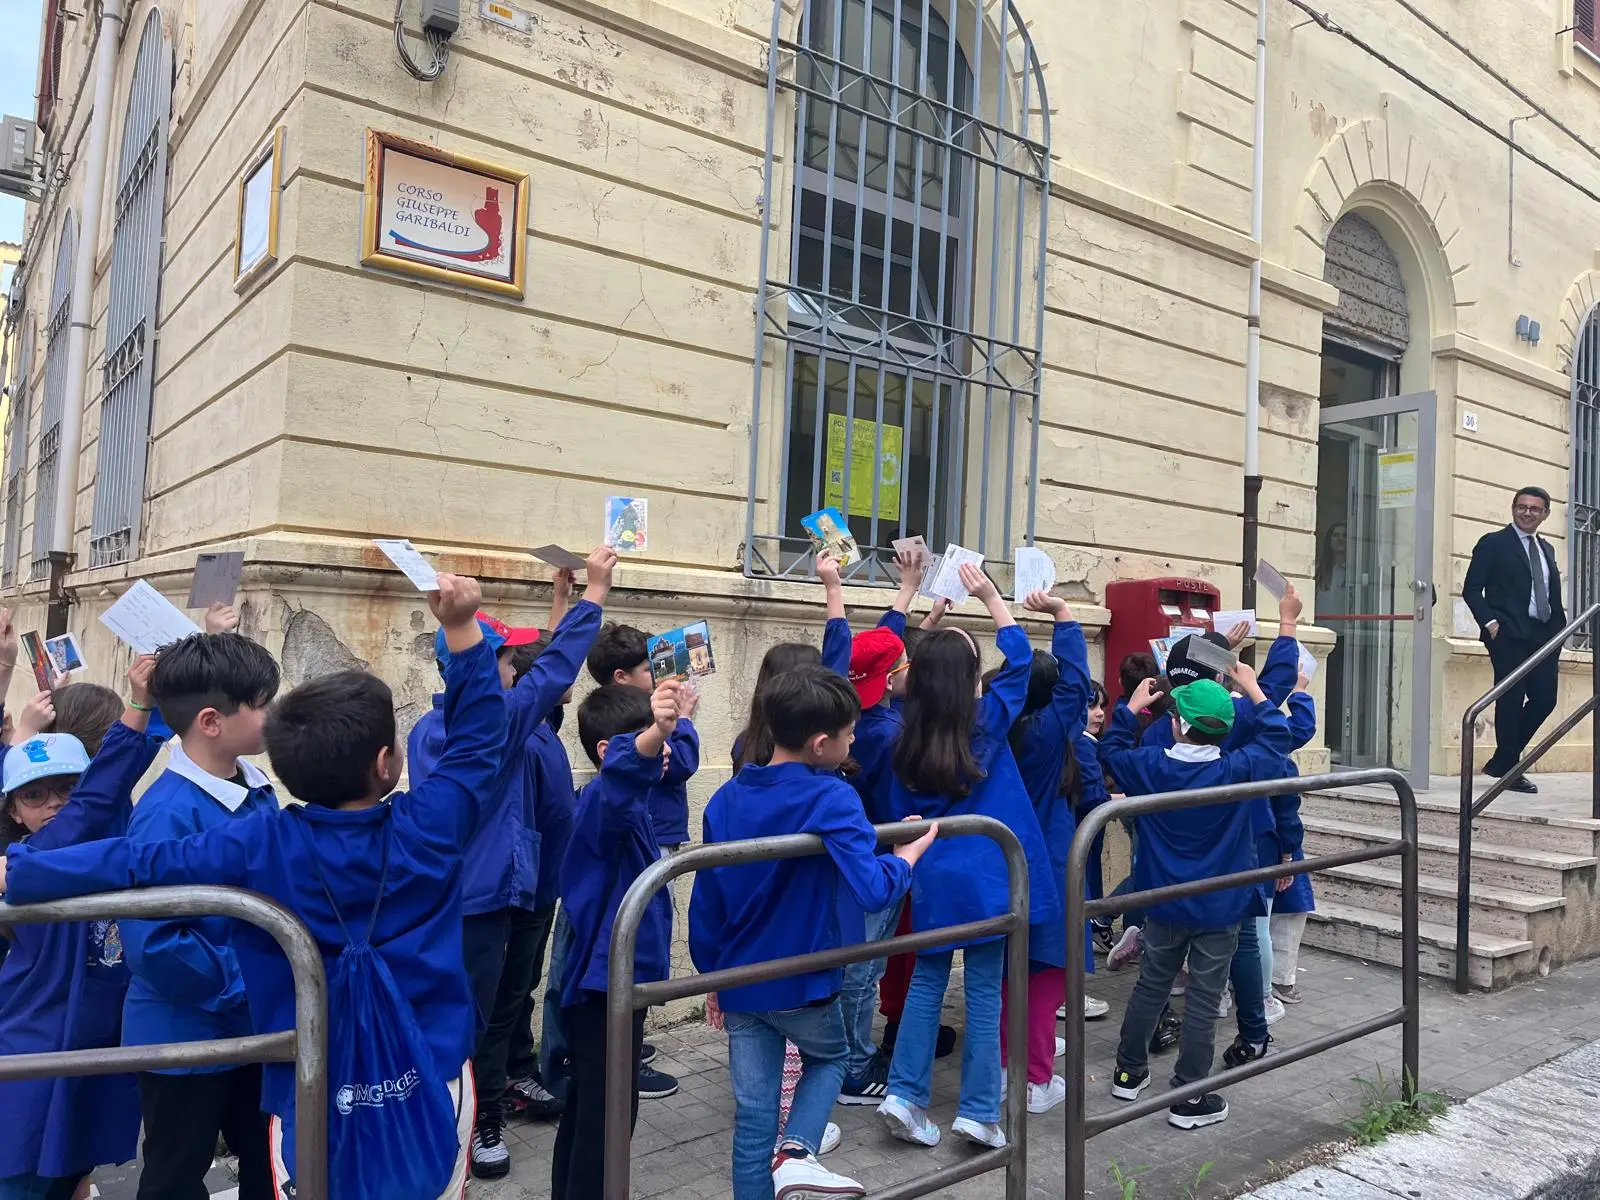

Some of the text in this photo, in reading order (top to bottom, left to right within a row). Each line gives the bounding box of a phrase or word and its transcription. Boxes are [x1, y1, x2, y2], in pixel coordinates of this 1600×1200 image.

[397, 182, 443, 202] CORSO
[396, 196, 460, 221] GIUSEPPE
[395, 210, 472, 237] GARIBALDI
[1176, 579, 1209, 592] POSTE
